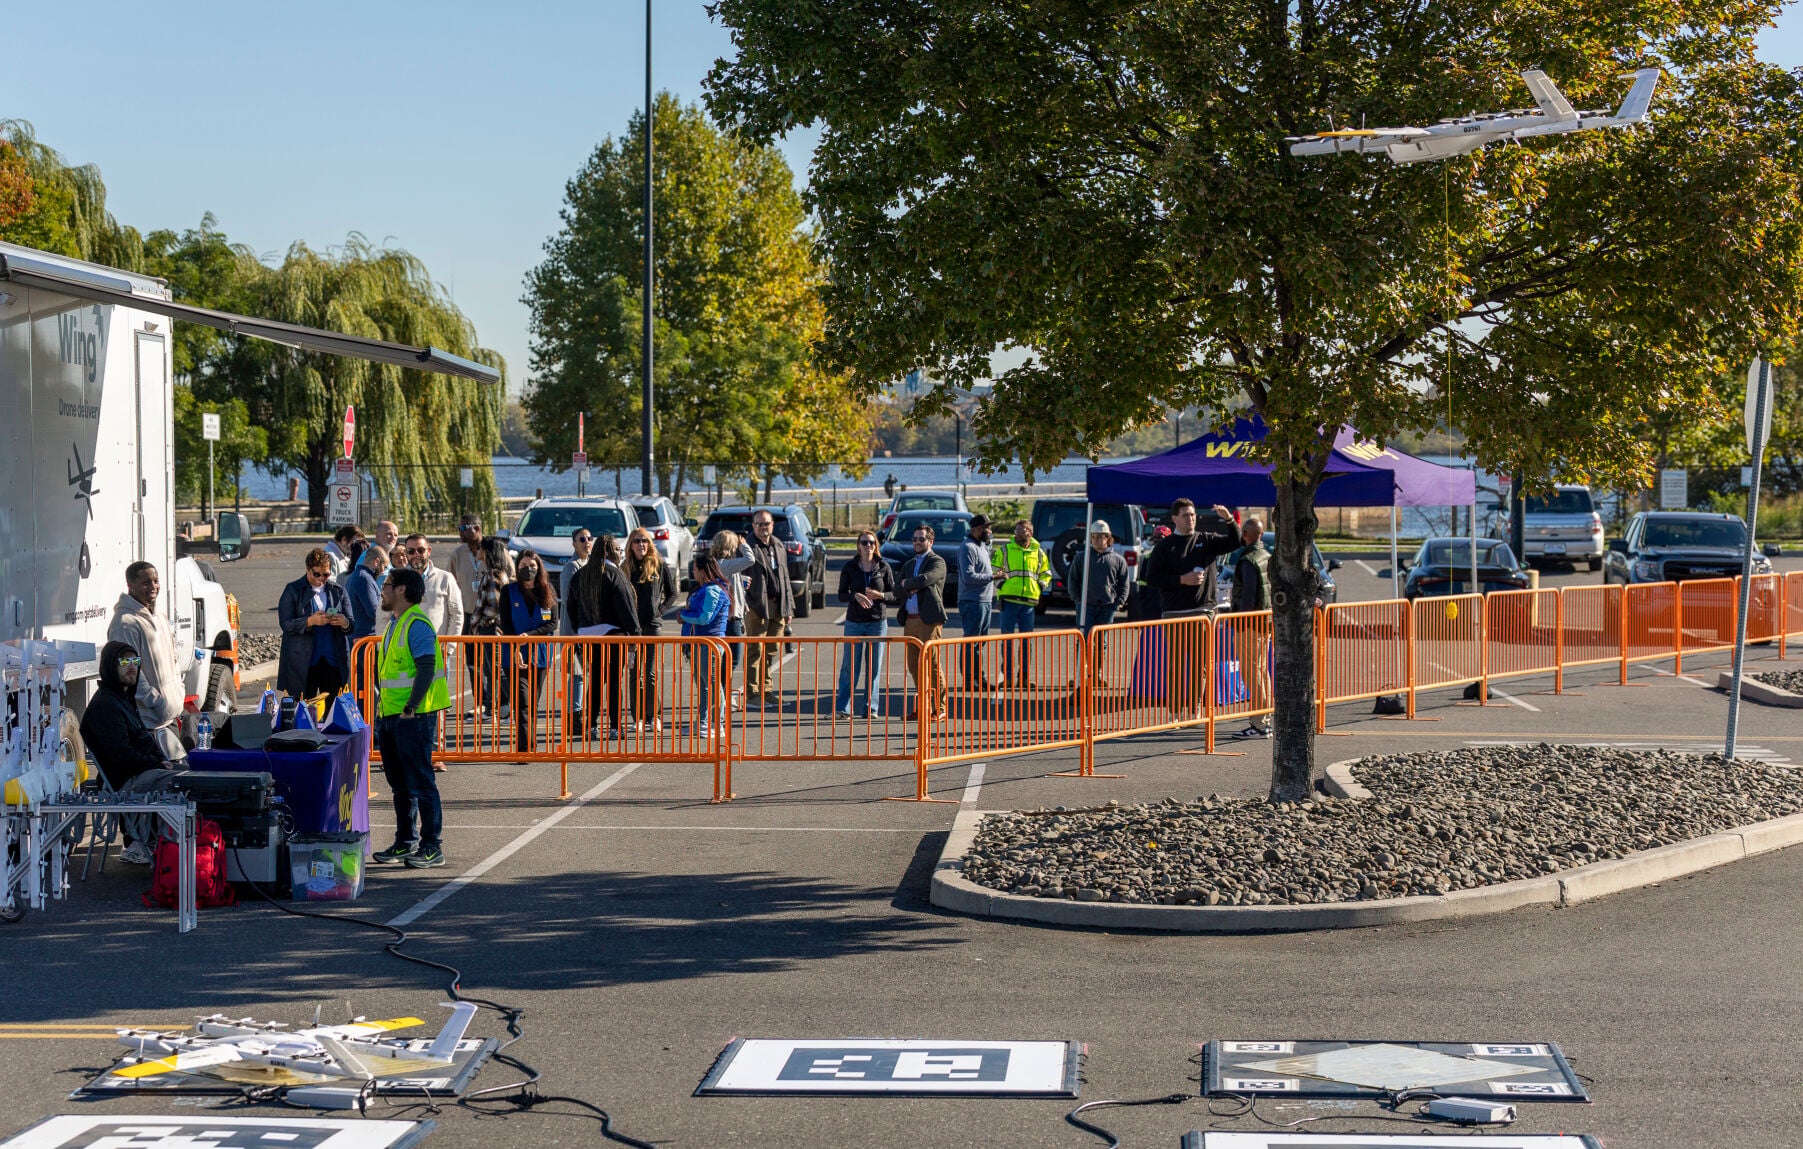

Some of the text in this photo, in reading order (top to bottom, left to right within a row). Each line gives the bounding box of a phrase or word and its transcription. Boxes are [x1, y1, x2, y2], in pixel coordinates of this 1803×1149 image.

[57, 311, 97, 384] Wing
[58, 398, 101, 422] Drone delivery
[335, 508, 352, 516] TRUCK
